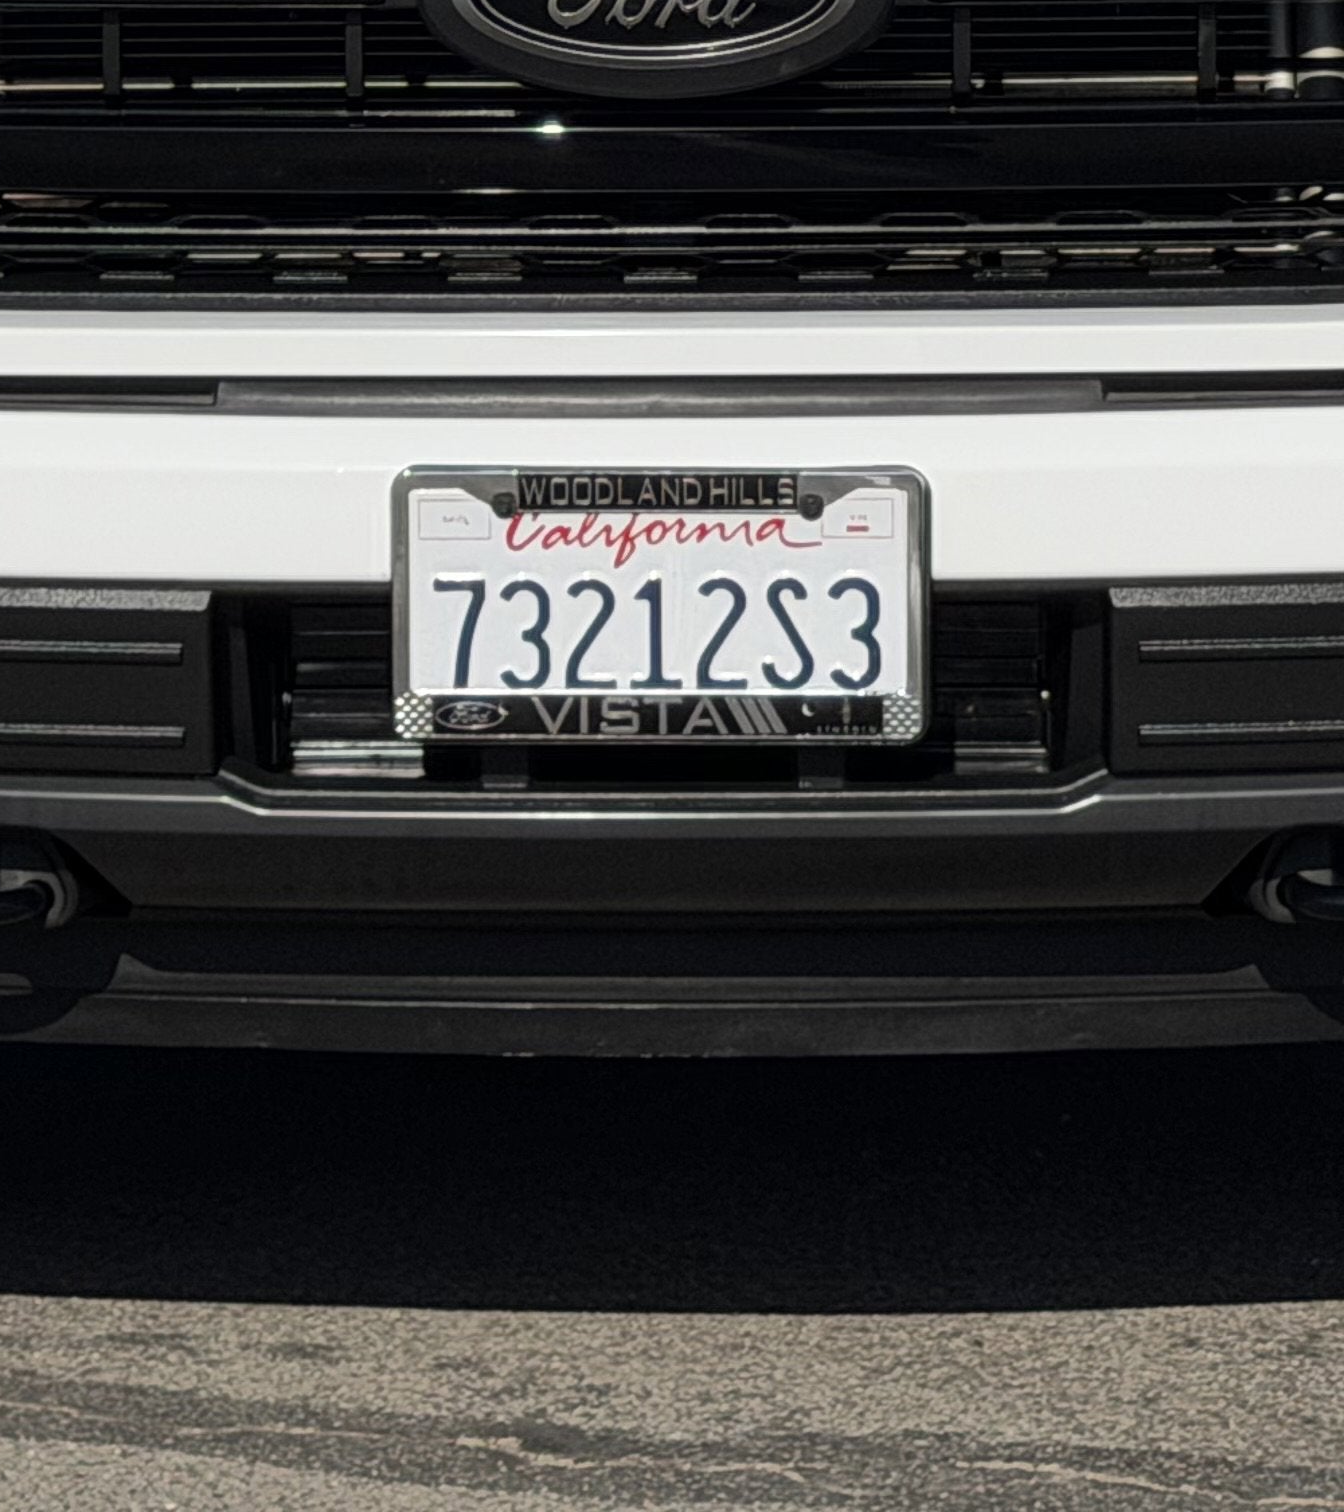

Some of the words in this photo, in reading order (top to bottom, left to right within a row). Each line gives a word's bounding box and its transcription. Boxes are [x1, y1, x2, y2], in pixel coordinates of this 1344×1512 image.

[519, 476, 703, 507] WOODLAND
[708, 476, 795, 506] HILLS
[505, 511, 823, 569] California
[432, 576, 882, 690] 73212S3
[531, 696, 734, 735] VISTA
